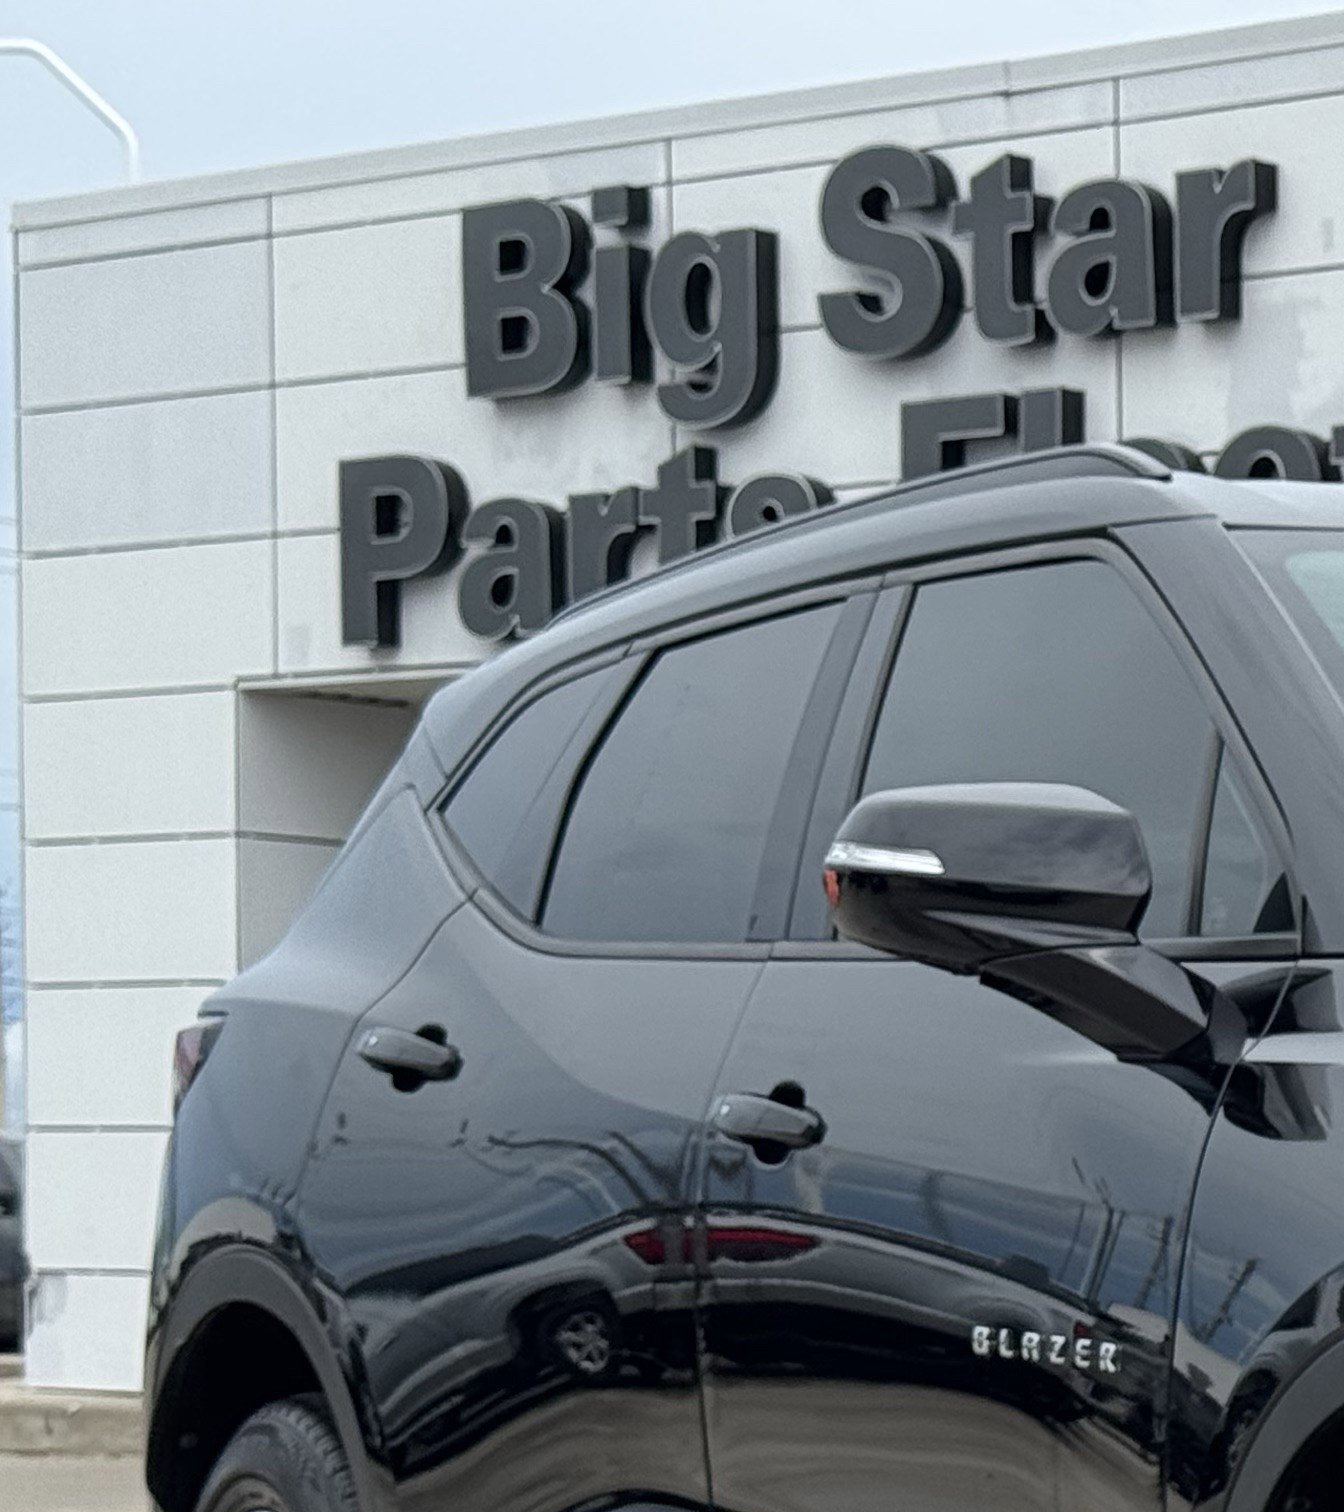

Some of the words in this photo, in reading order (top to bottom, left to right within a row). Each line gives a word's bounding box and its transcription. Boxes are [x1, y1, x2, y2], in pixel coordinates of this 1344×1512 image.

[463, 186, 780, 431] Big
[818, 144, 1280, 361] Star
[972, 1325, 1119, 1374] BLAZER
